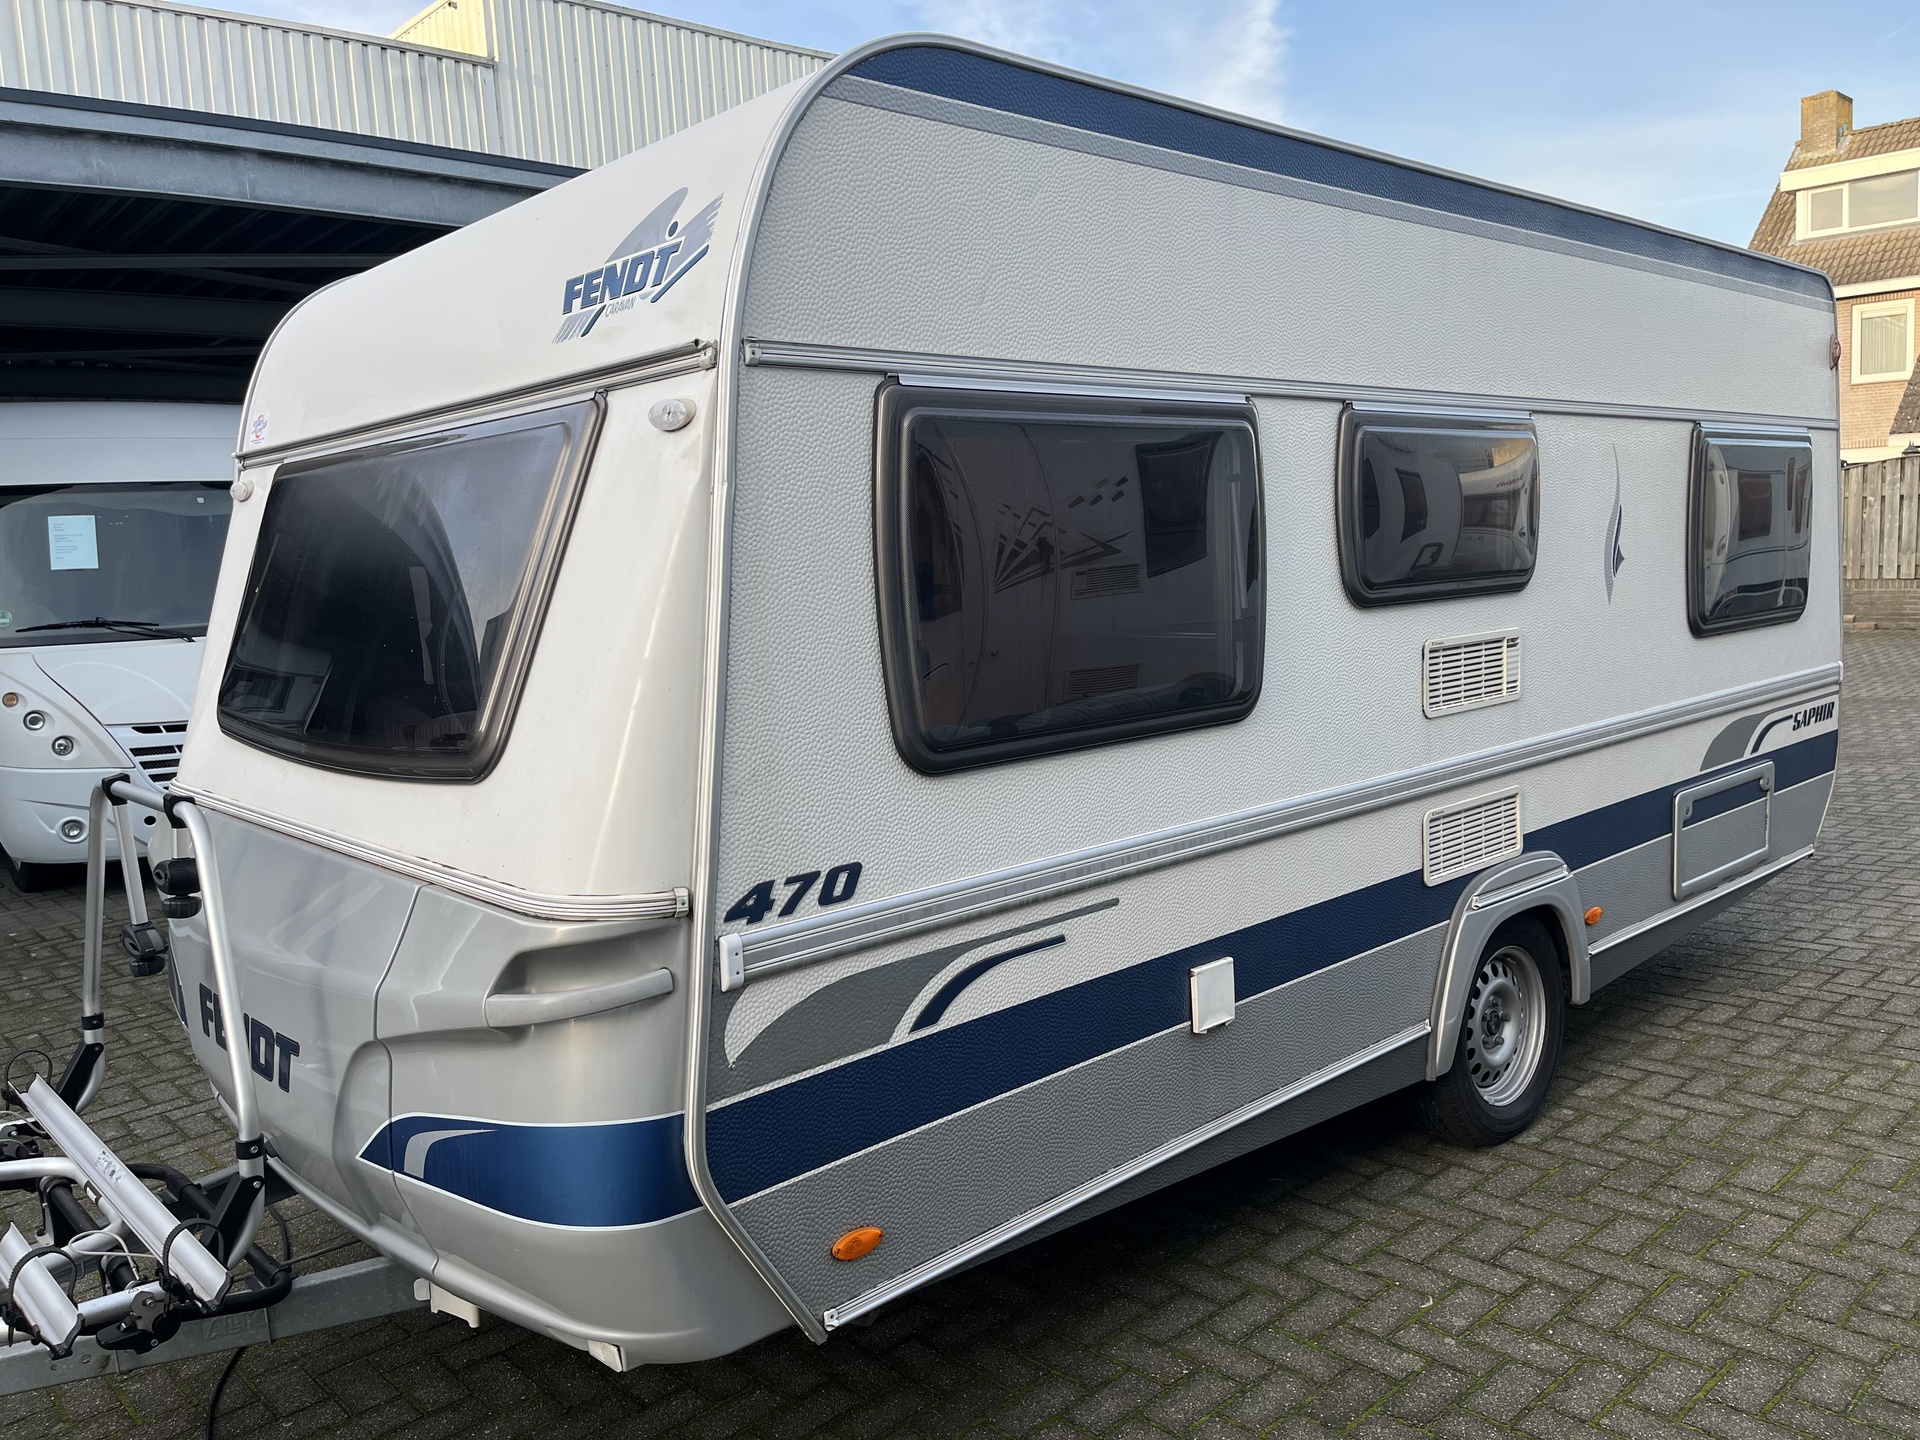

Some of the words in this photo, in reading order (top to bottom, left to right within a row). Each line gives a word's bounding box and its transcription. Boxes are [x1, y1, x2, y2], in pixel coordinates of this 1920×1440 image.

[562, 240, 683, 316] FENDT
[605, 296, 637, 318] CARAVAN
[1792, 701, 1835, 731] SAPHIR
[723, 861, 863, 926] 470
[199, 982, 300, 1094] FEDT
